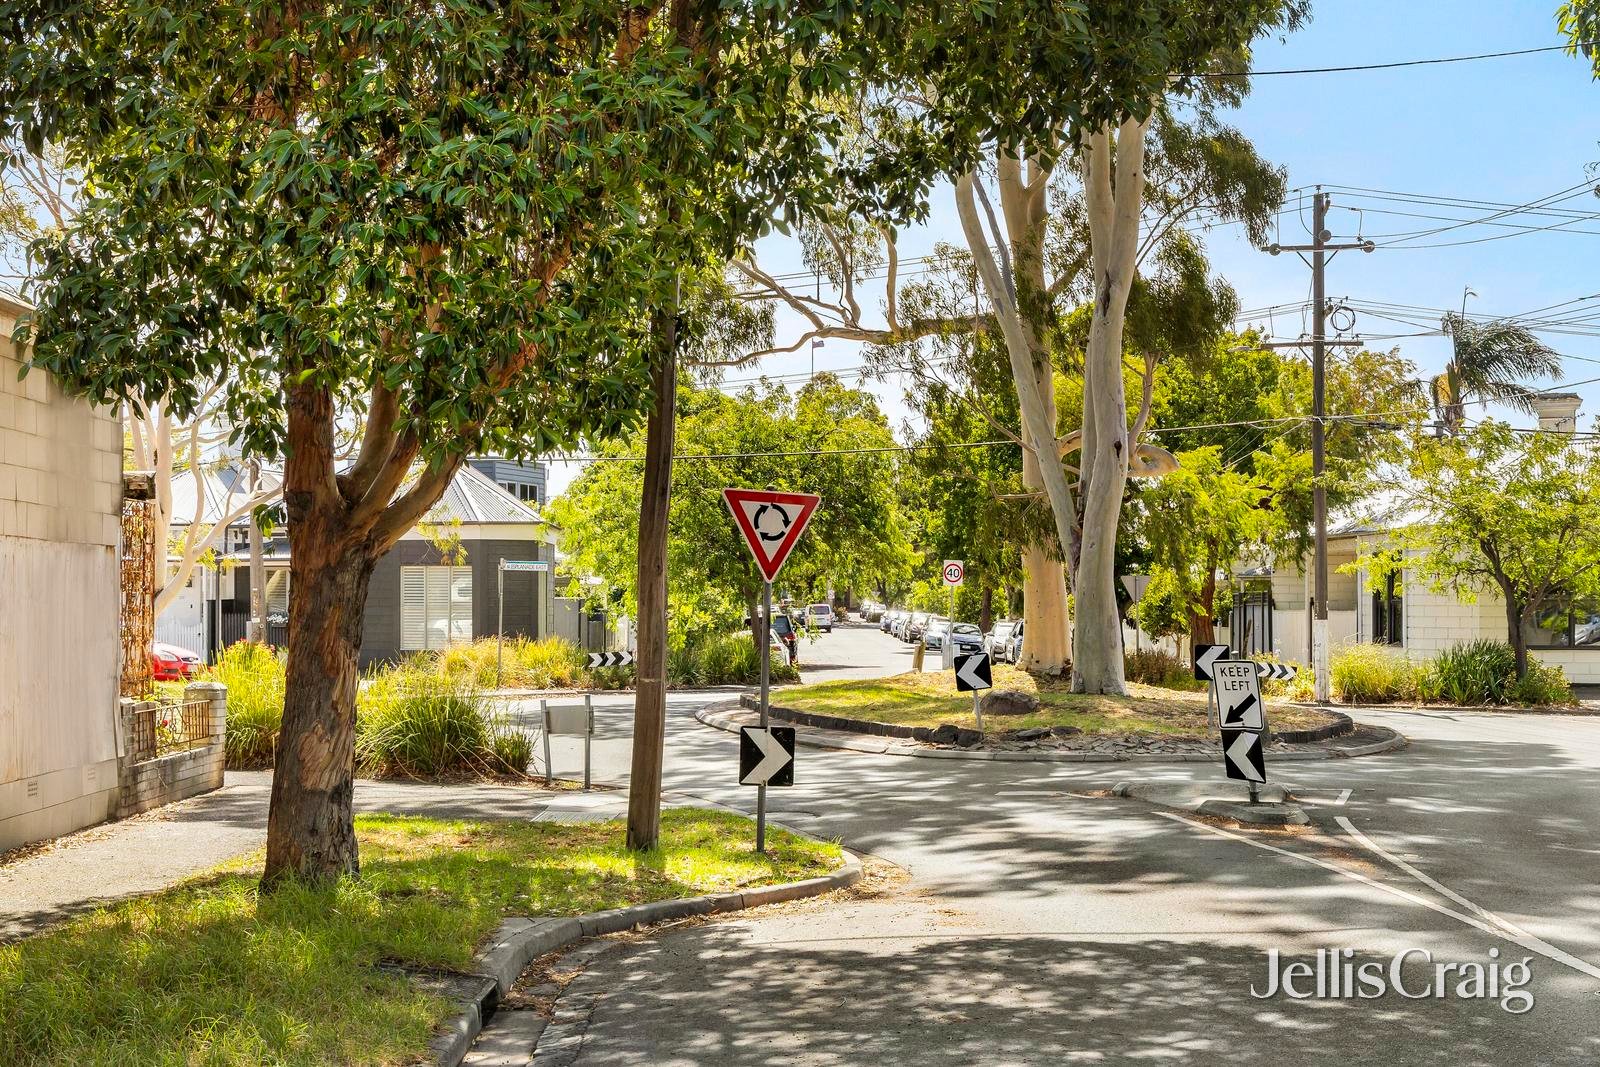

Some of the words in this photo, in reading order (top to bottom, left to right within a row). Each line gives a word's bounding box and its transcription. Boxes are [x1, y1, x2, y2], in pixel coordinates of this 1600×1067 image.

[946, 568, 960, 578] 40
[1220, 666, 1250, 677] KEEP
[1224, 680, 1250, 691] LEFT
